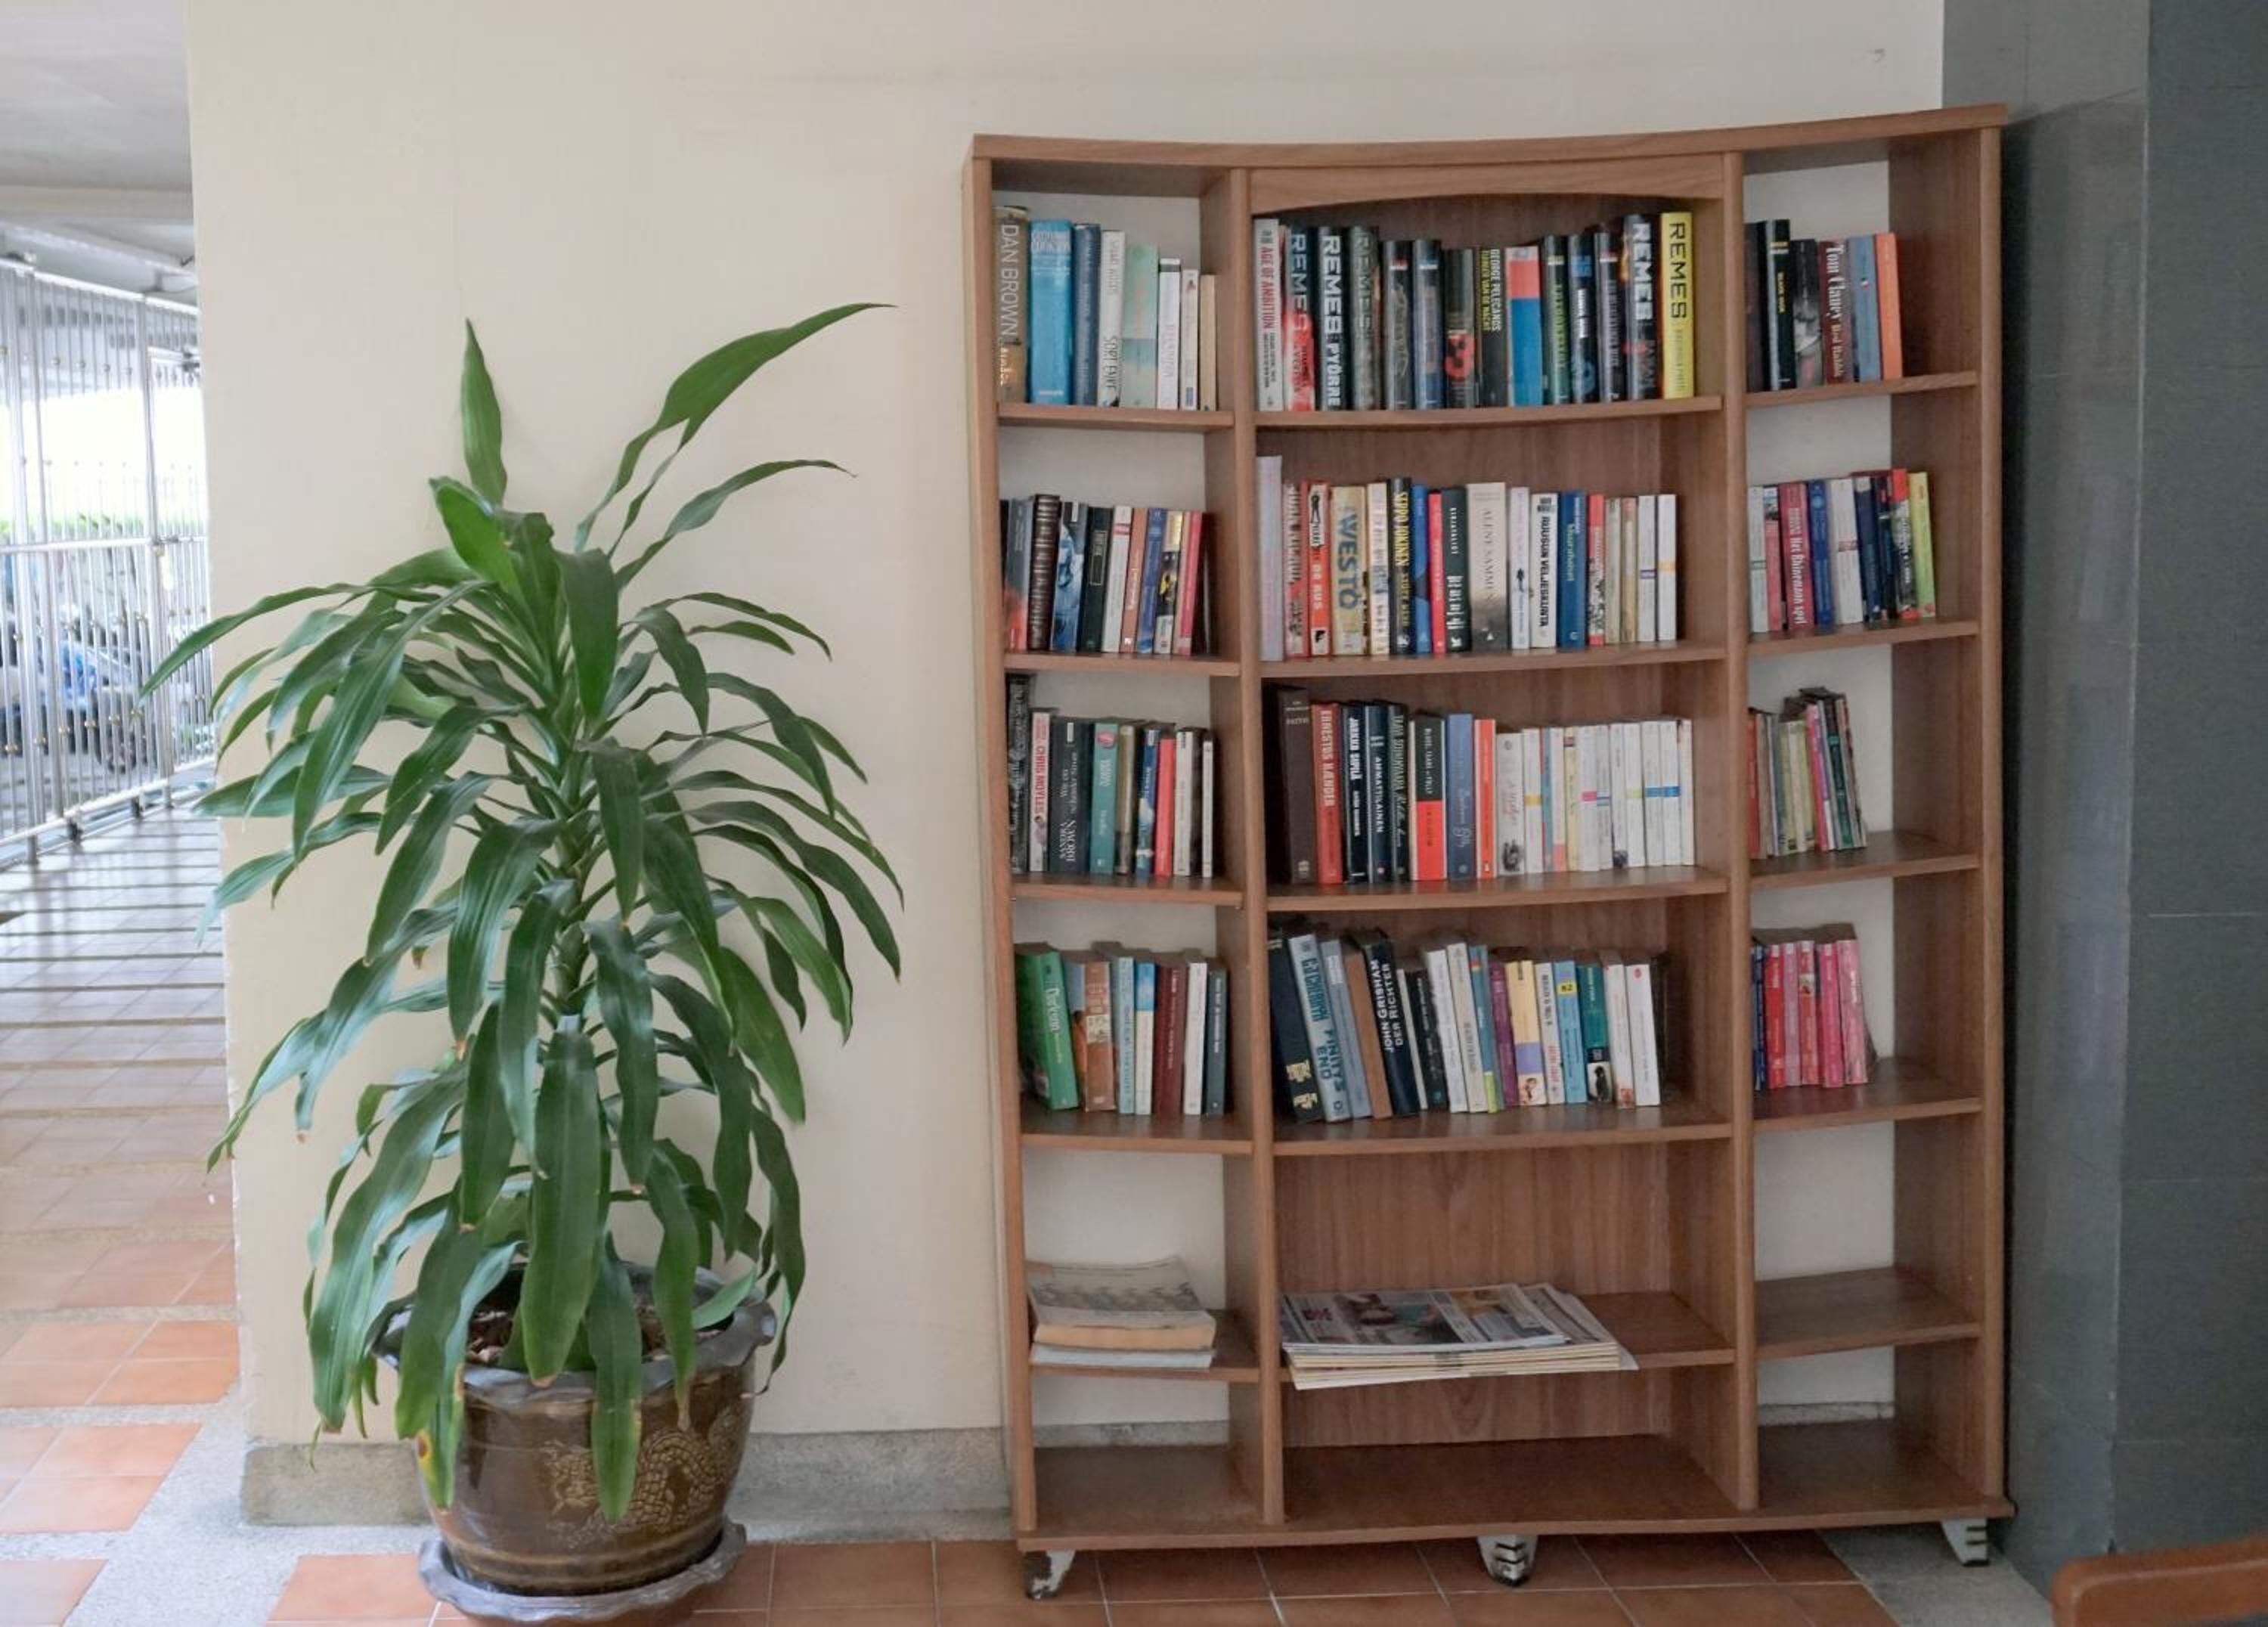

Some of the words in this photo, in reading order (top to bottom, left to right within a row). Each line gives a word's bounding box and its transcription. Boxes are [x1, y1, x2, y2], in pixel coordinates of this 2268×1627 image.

[1000, 225, 1020, 263] DAN
[1826, 244, 1845, 273] Tom
[1290, 234, 1309, 330] REMES
[1324, 235, 1343, 334] REMES
[1633, 222, 1653, 320] REMES
[1669, 222, 1687, 319] REMES
[999, 268, 1019, 336] BROWN
[1261, 281, 1276, 330] AMBITION
[1491, 283, 1502, 331] PELECANOS
[1826, 277, 1847, 320] Clancy
[1328, 343, 1344, 406] PYÖRRE
[1394, 491, 1408, 522] SEPPO
[1337, 514, 1363, 610] WESTÖ
[1394, 524, 1409, 566] JOKINEN
[1539, 559, 1551, 627] VELJESKUNTA
[1034, 745, 1048, 774] CHRIS
[1034, 775, 1048, 815] MOYLES
[1065, 820, 1077, 862] BROWN
[1370, 959, 1388, 1020] GRISHAM
[1380, 962, 1399, 1019] RICHTER
[1383, 1021, 1396, 1053] JOHN
[1390, 1024, 1404, 1046] DER
[1316, 1046, 1332, 1080] END
